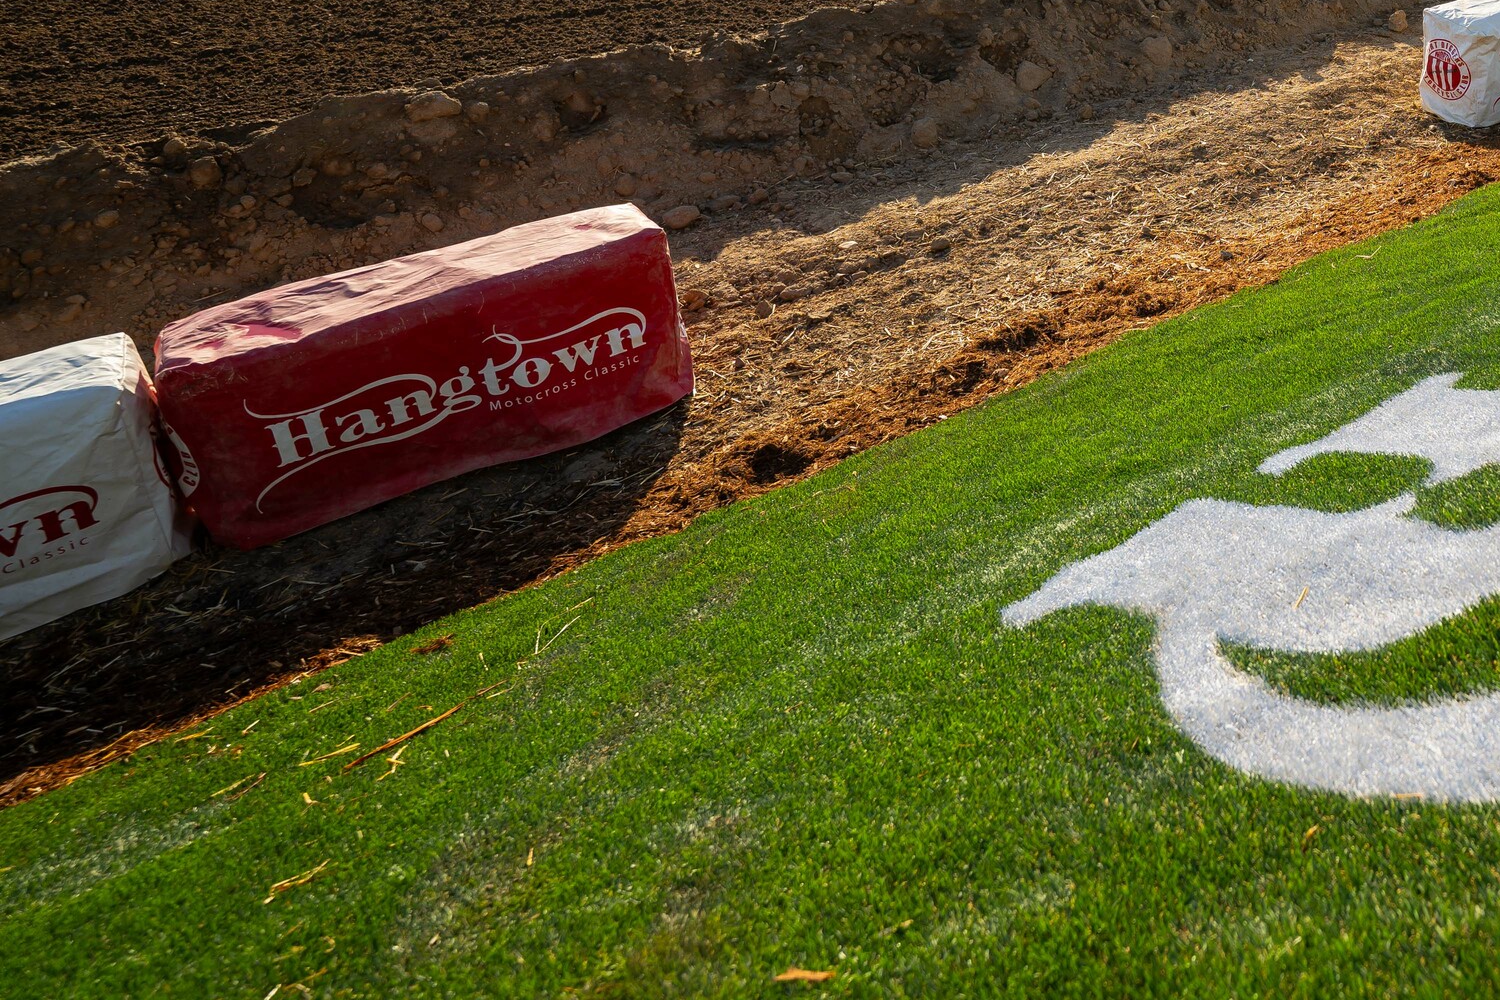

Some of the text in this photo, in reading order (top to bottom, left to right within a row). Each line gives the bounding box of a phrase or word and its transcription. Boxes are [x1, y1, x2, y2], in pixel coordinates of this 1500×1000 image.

[1456, 74, 1469, 96] CLUB
[256, 307, 648, 485] Hangtown
[489, 354, 641, 412] Motocross Classic
[2, 536, 90, 575] Classic
